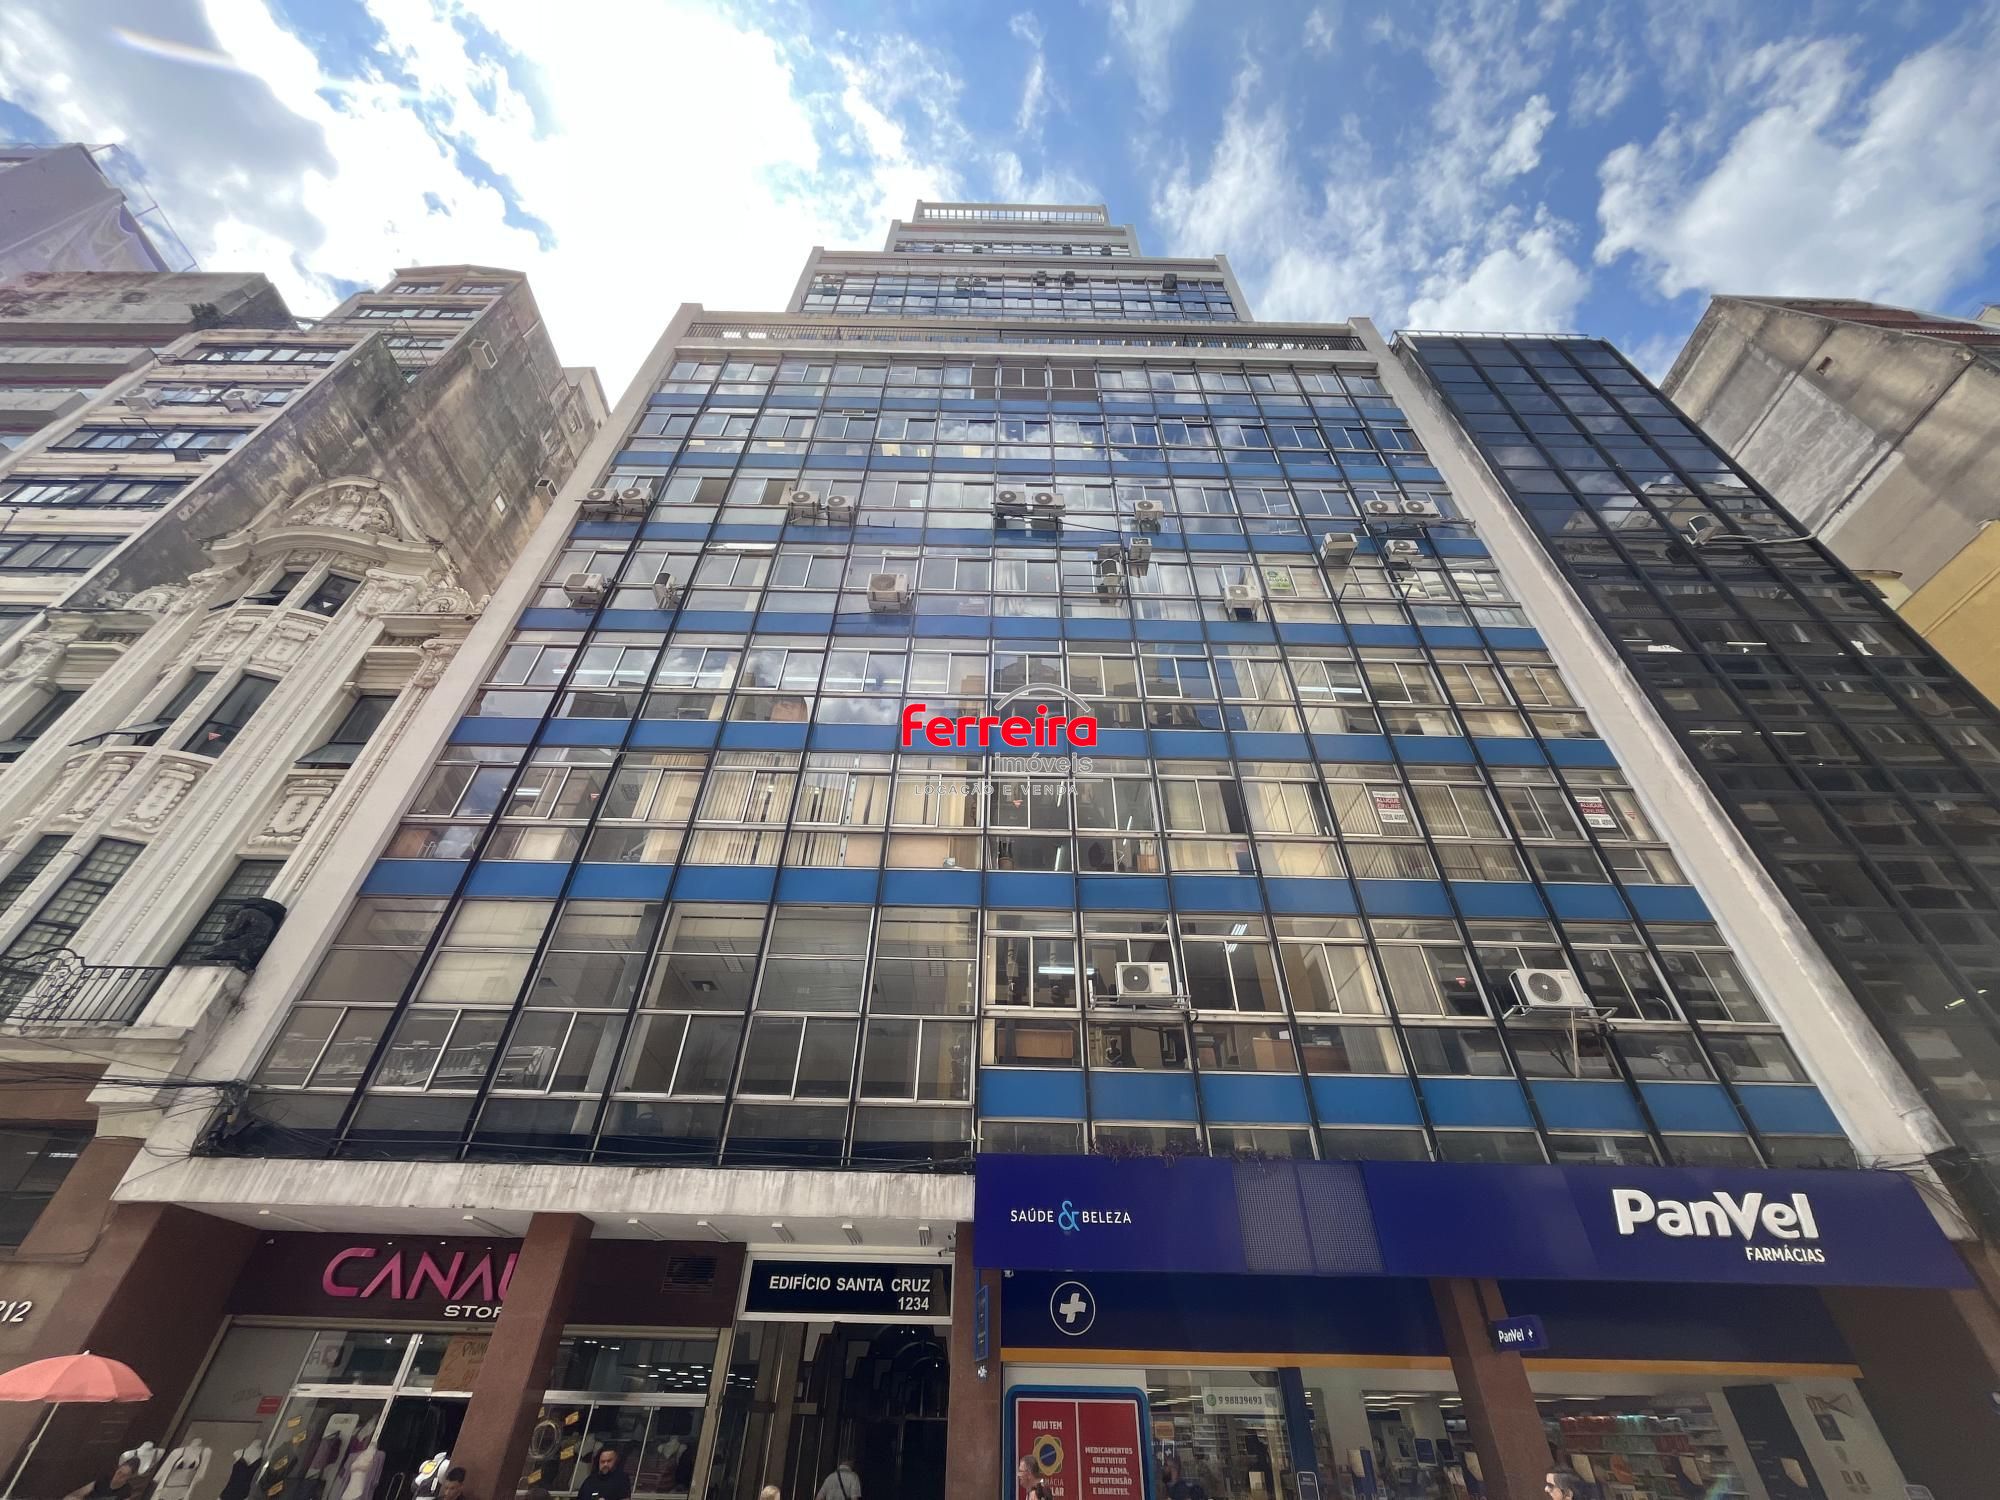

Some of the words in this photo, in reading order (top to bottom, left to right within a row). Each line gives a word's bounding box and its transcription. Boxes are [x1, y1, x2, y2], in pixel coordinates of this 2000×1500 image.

[1010, 1207, 1054, 1223] SAÚDE
[1058, 1200, 1080, 1231] &
[1082, 1211, 1132, 1224] BELEZA
[1612, 1188, 1820, 1241] PanVel
[1745, 1245, 1825, 1263] FARMÁCIAS
[769, 1274, 831, 1291] EDIFÍCIO
[836, 1277, 884, 1292] SANTA
[891, 1278, 931, 1293] CRUZ
[898, 1296, 930, 1311] 1234
[1498, 1328, 1525, 1343] PanVel
[1032, 1421, 1049, 1430] AQUI
[1050, 1421, 1063, 1430] TEM
[1085, 1447, 1133, 1455] MEDICAMENTOS
